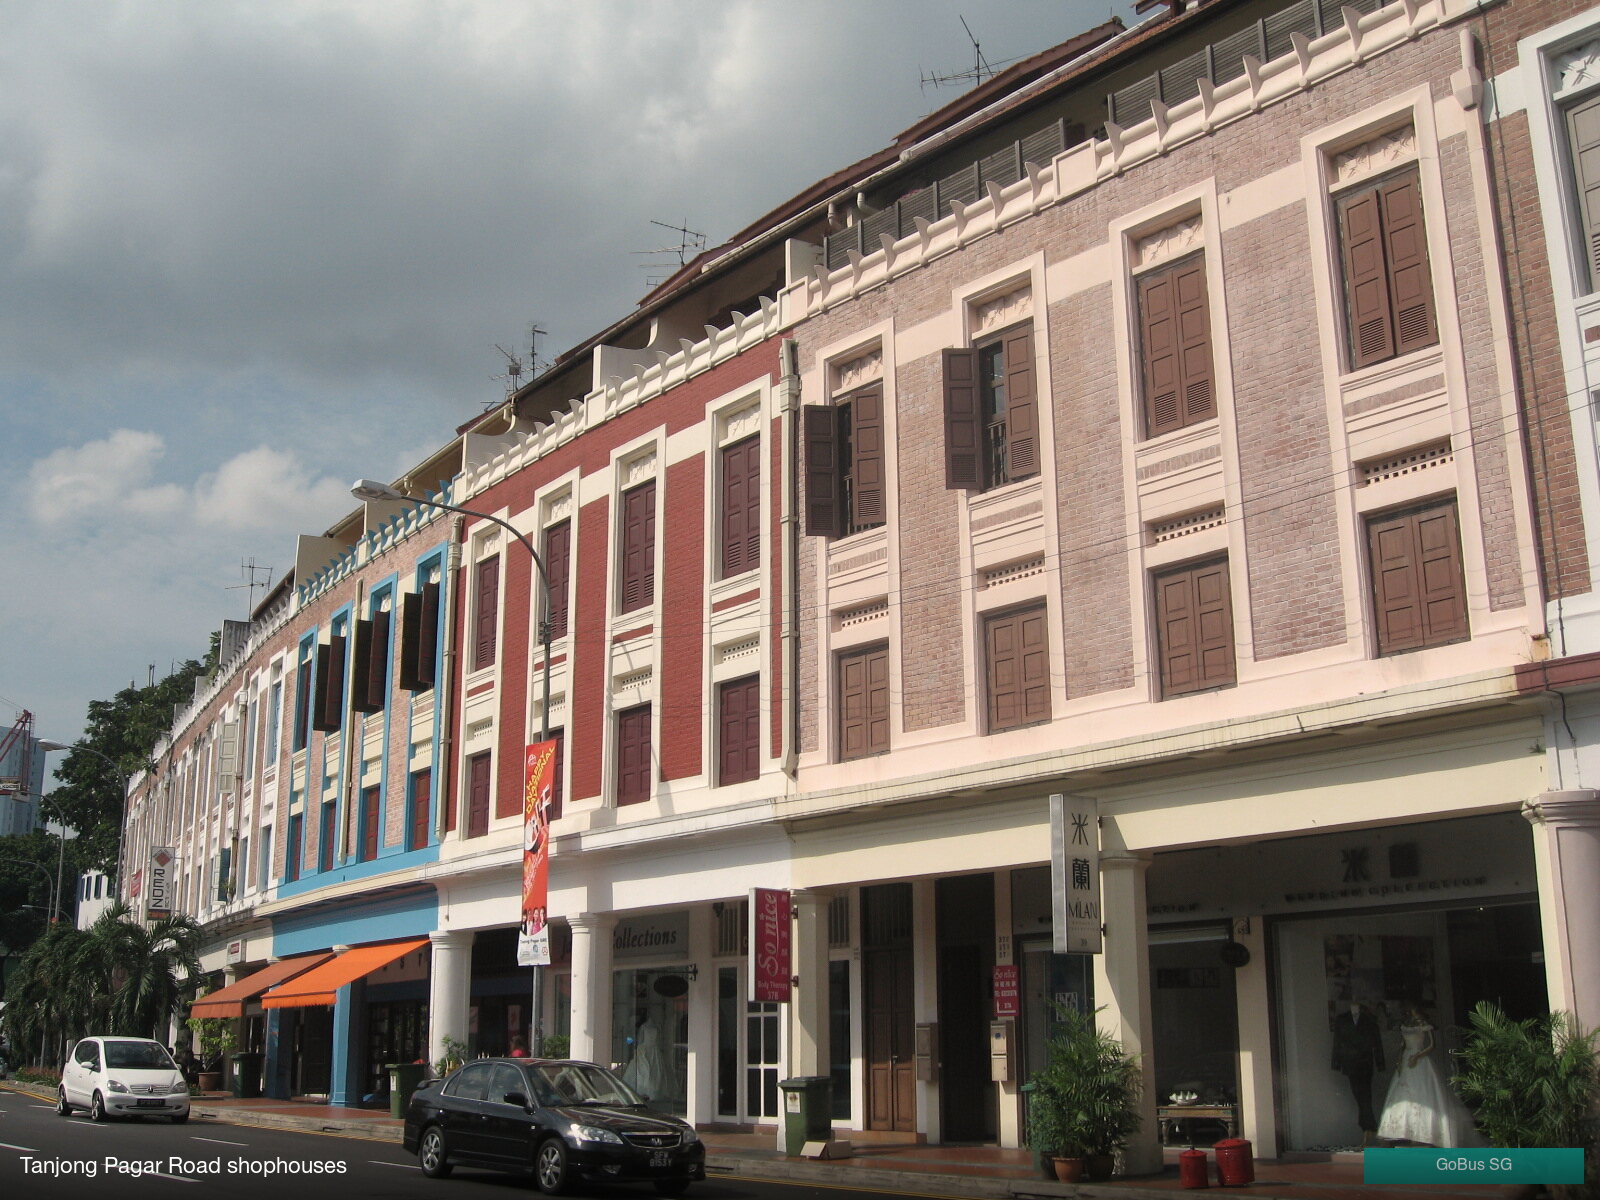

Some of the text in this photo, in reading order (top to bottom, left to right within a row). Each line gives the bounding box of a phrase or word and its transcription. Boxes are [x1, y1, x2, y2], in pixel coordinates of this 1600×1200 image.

[526, 750, 544, 791] HAPPY
[152, 868, 165, 908] REDZ
[613, 926, 677, 950] ollections
[758, 893, 779, 977] So nice
